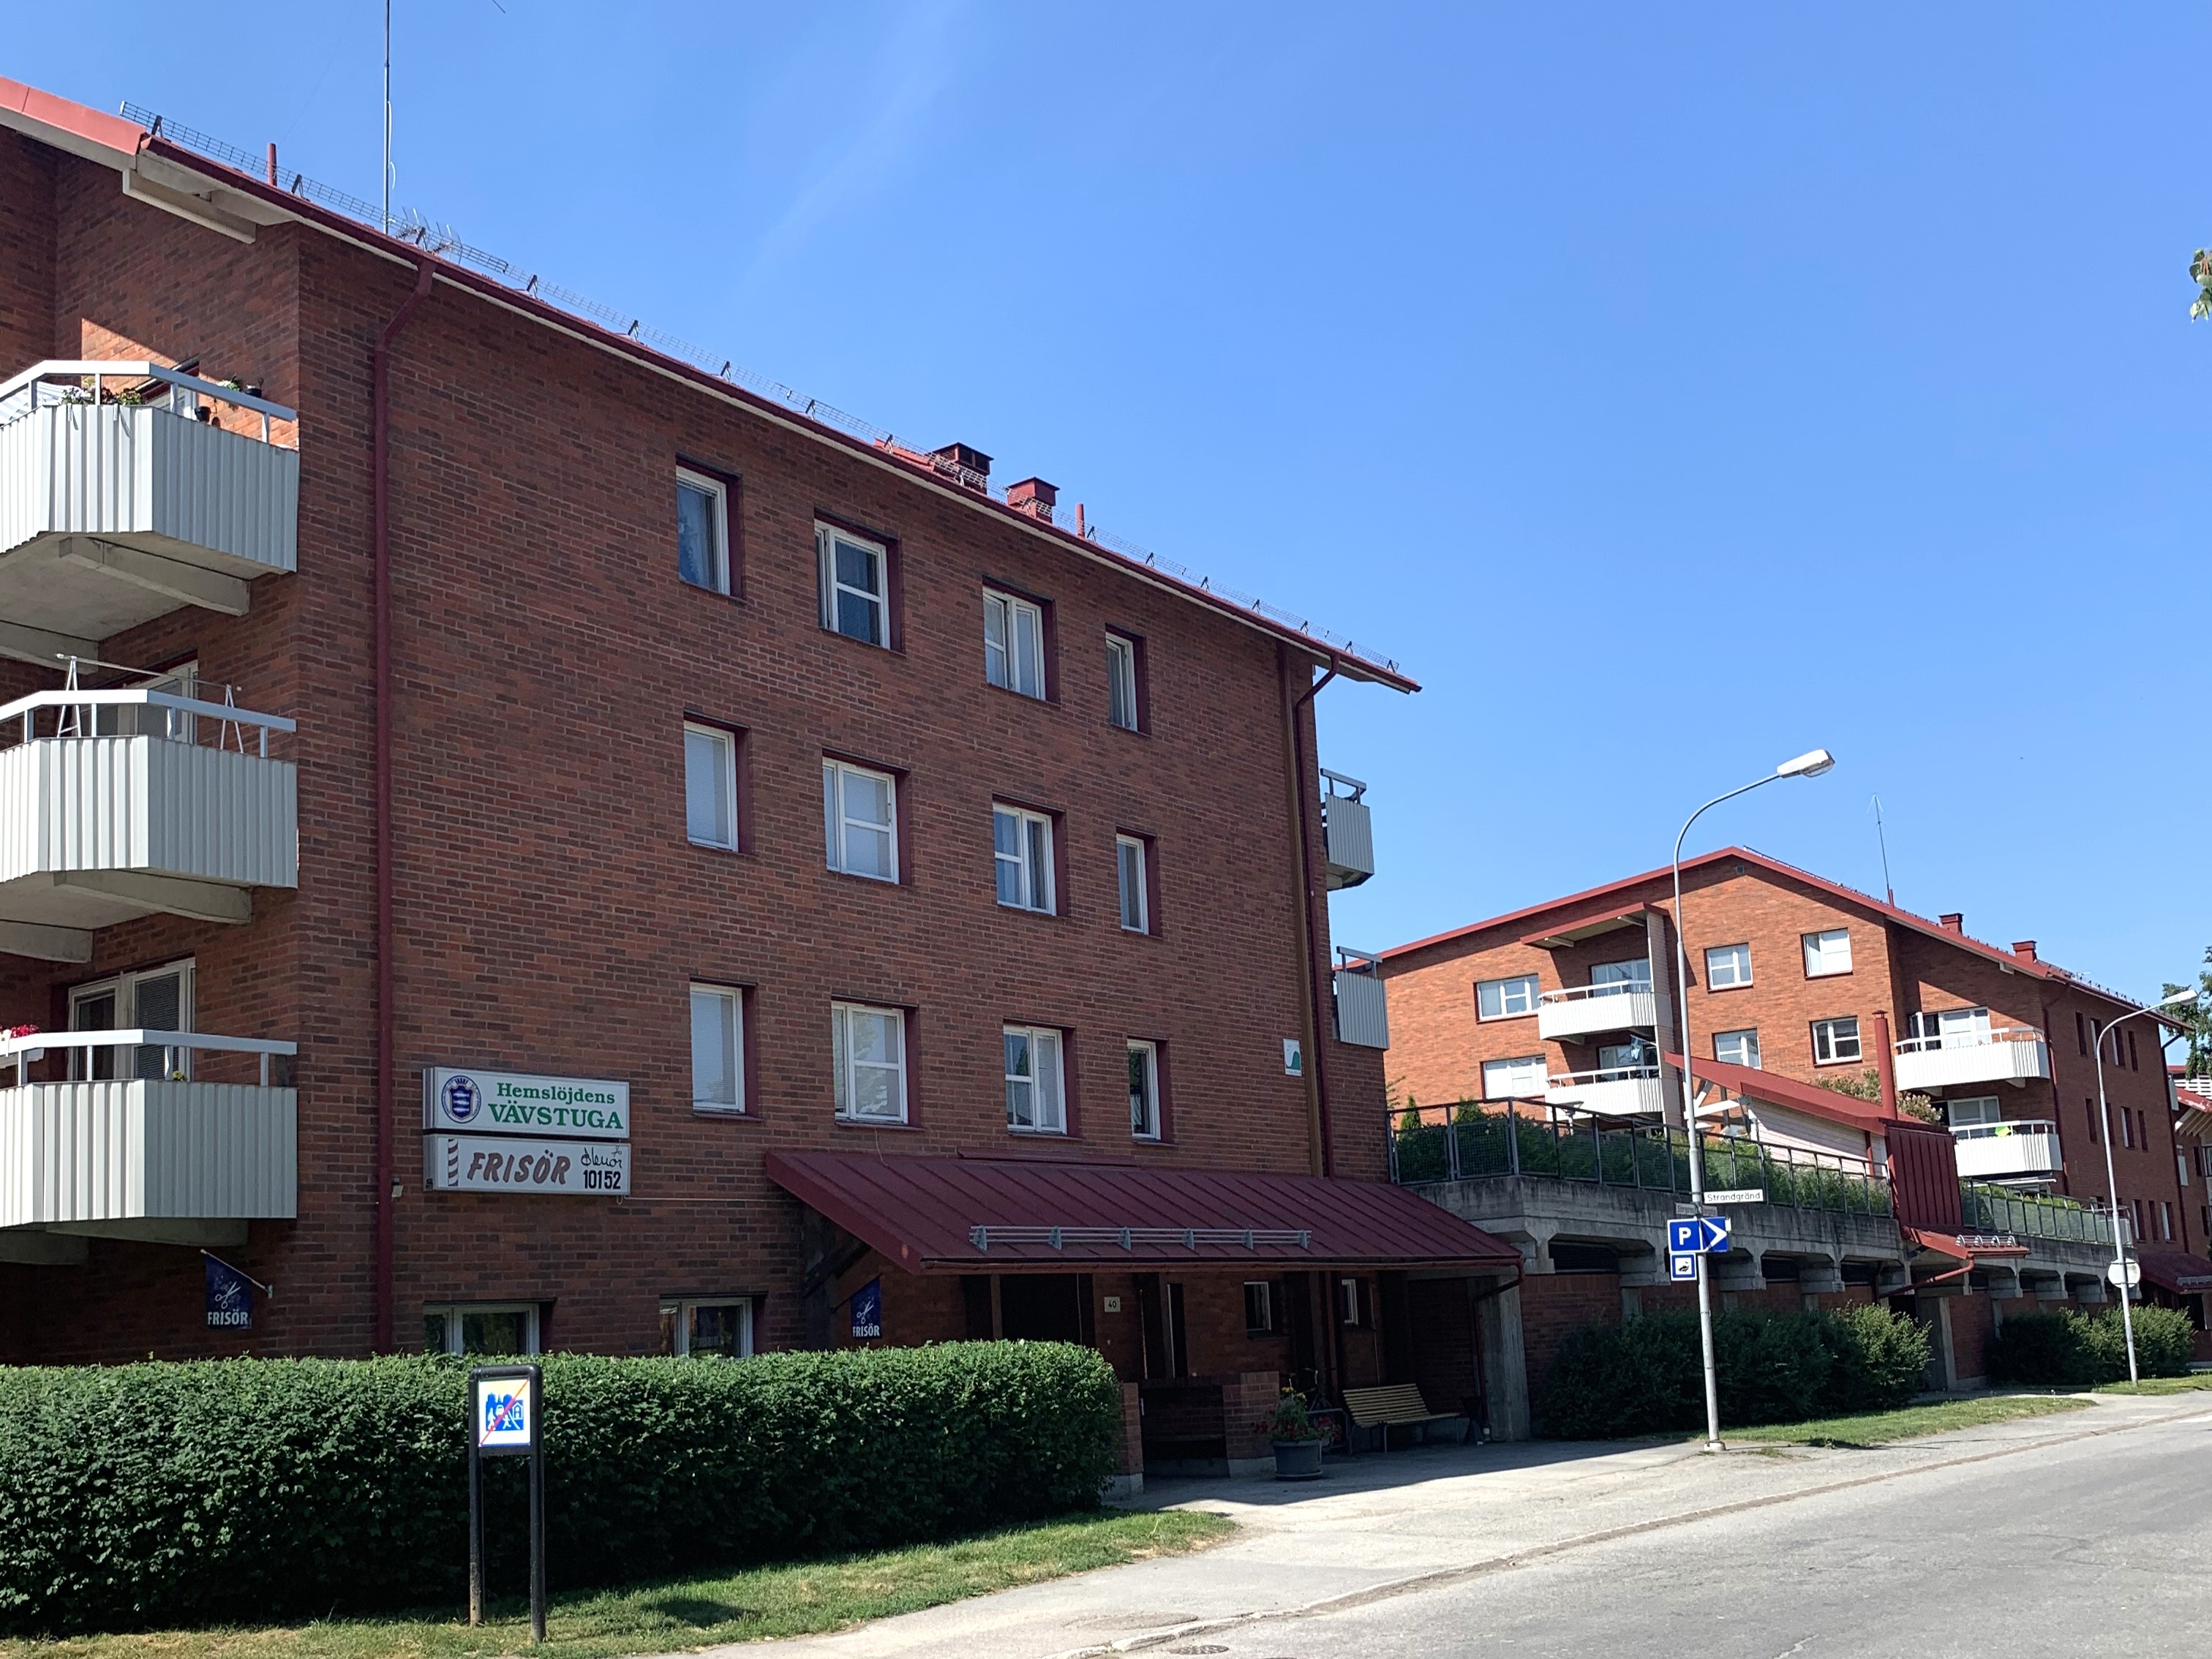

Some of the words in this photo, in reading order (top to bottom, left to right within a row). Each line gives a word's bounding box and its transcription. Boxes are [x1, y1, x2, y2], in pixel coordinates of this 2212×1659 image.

[497, 1083, 615, 1105] Hemslöjdens
[488, 1100, 623, 1129] VÄVSTUGA
[467, 1149, 571, 1185] FRISÖR
[583, 1170, 621, 1189] 10152
[1707, 1192, 1761, 1203] Strandgränd
[1678, 1227, 1691, 1246] P
[208, 1309, 248, 1325] FRISÖR
[852, 1323, 880, 1337] FRISÖR
